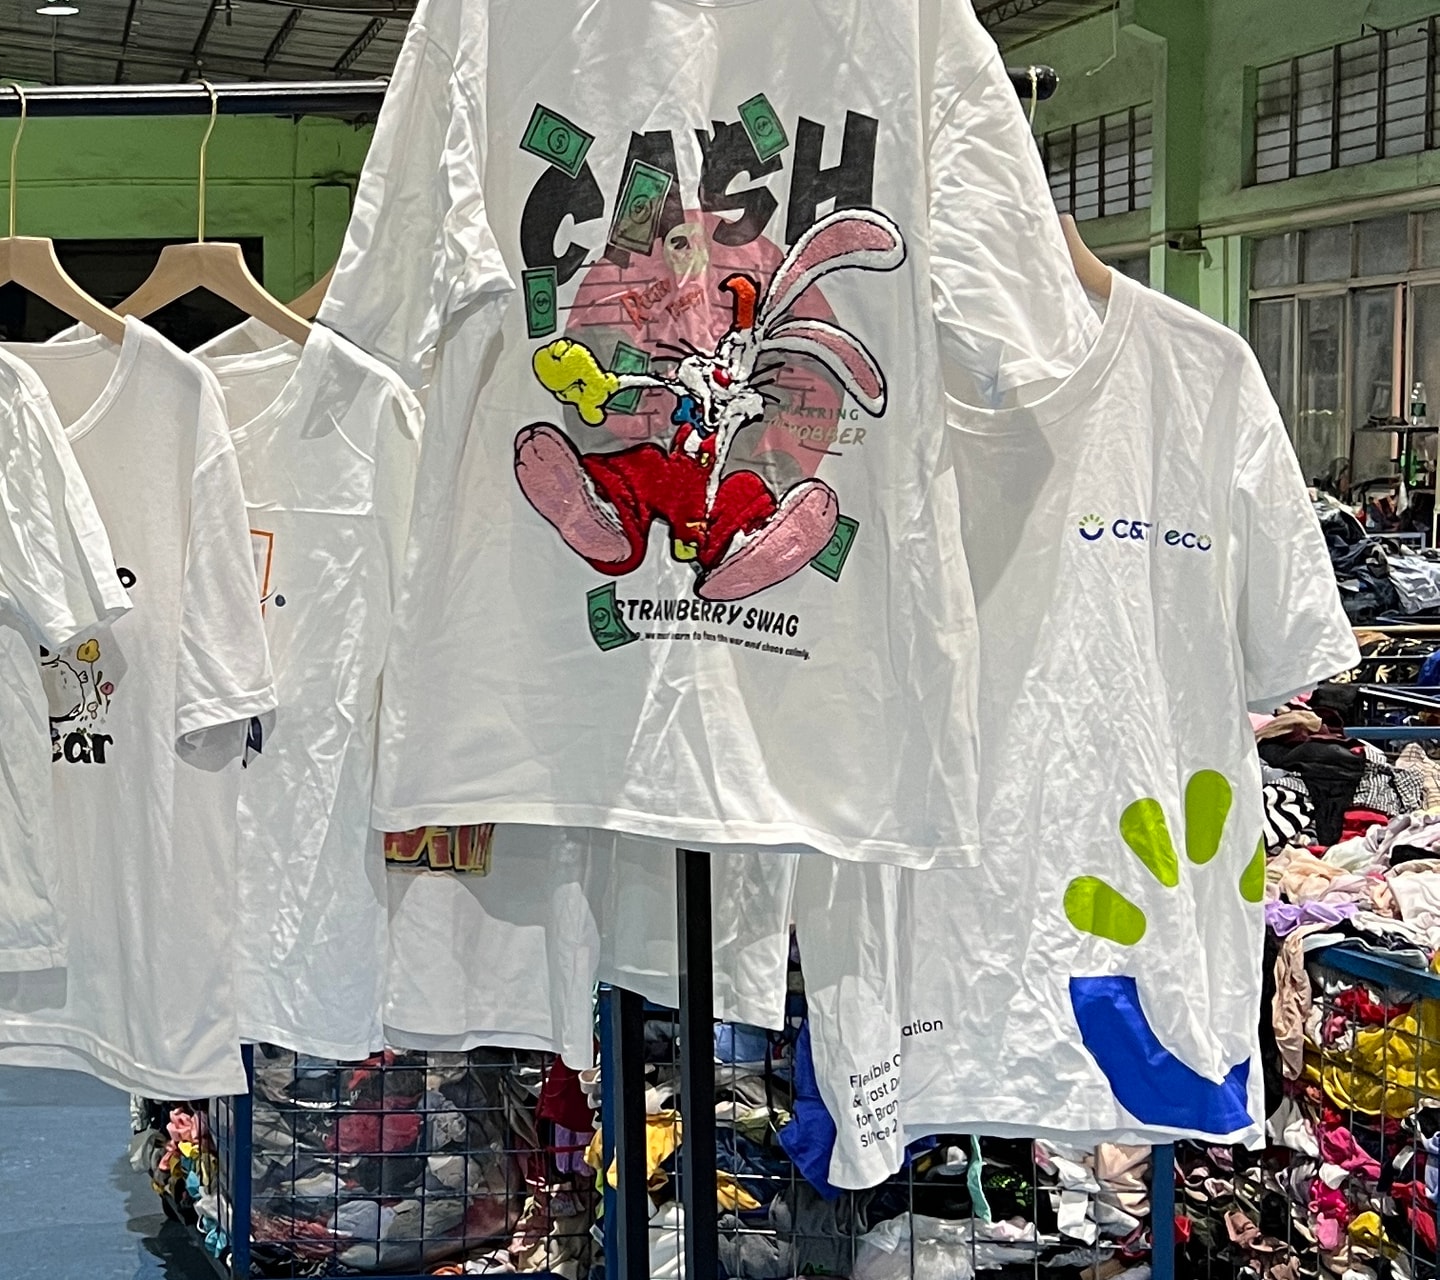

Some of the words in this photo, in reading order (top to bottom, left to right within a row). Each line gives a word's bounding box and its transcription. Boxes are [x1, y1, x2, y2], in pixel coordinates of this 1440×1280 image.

[520, 109, 879, 287] CASH
[1164, 529, 1212, 551] eco
[615, 598, 743, 625] STRAWBERRY
[743, 607, 800, 637] SWAG
[901, 1019, 944, 1037] ation
[856, 1113, 874, 1129] for
[875, 1099, 899, 1122] Bran
[860, 1126, 891, 1148] Since
